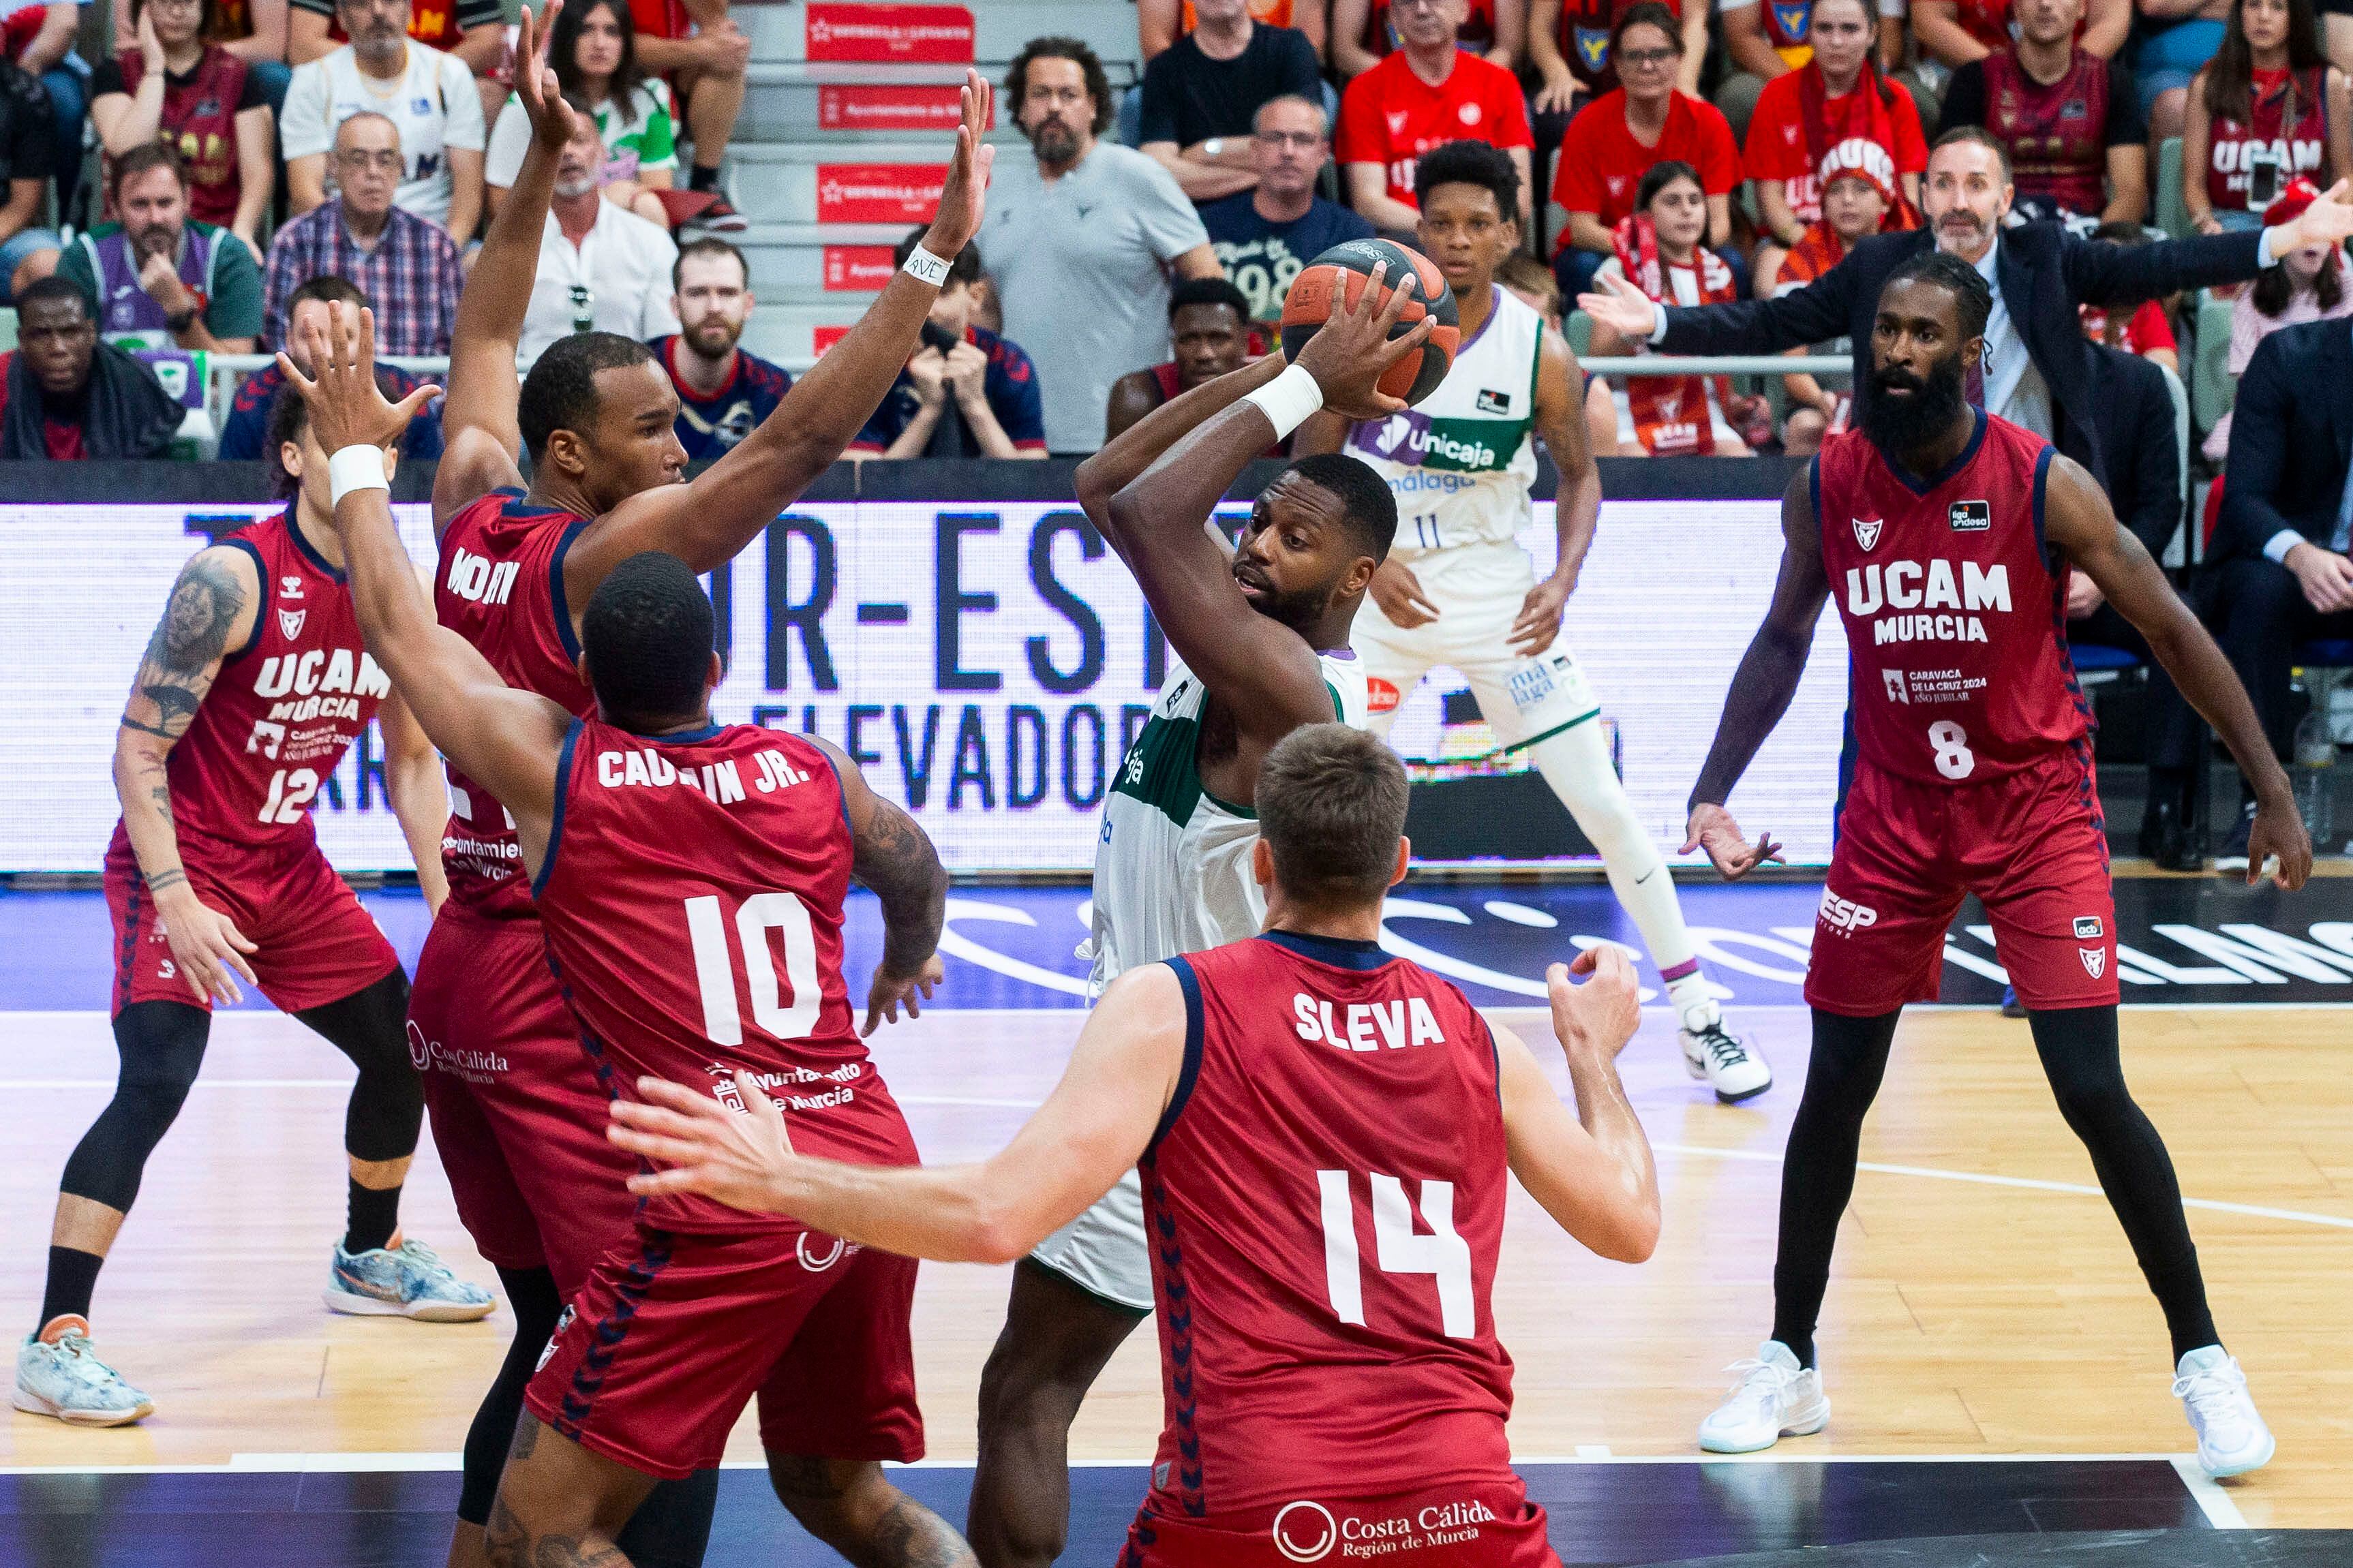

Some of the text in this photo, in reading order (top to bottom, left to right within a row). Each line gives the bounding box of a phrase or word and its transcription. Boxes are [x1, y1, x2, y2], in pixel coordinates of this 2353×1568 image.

[1409, 429, 1495, 469] Unicaja
[1414, 513, 1442, 549] 11
[1952, 510, 1968, 519] liga
[1847, 559, 2013, 616] UCAM
[1874, 615, 1988, 645] MURCIA
[254, 649, 392, 699] UCAM
[1909, 669, 1962, 680] CARAVACA
[1911, 677, 1987, 692] DE LA CRUZ 2024
[267, 695, 359, 722] MURCIA
[1928, 720, 1975, 780] 8
[753, 749, 811, 794] JR.
[258, 768, 319, 824] 12
[684, 892, 823, 1047] 10
[1295, 992, 1444, 1053] SLEVA
[1316, 1169, 1475, 1339] 14
[1341, 1499, 1496, 1540] Costa Cálida
[1342, 1526, 1479, 1559] Región de Murcia
